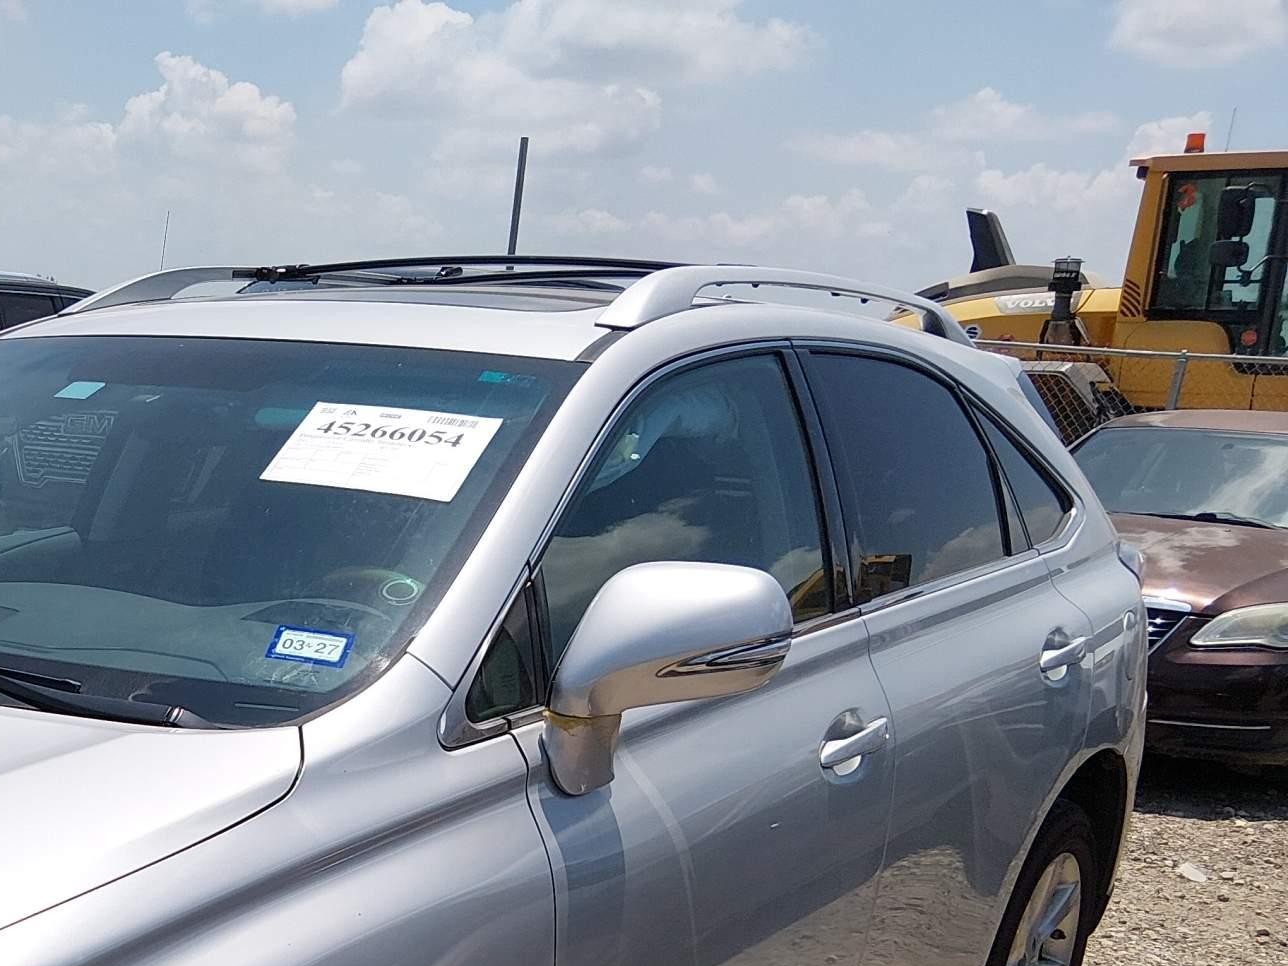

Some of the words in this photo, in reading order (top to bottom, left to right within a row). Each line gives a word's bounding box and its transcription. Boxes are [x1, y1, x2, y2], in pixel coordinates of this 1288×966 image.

[1006, 299, 1056, 308] VOLV
[63, 414, 114, 433] GM
[316, 420, 464, 447] 45266054
